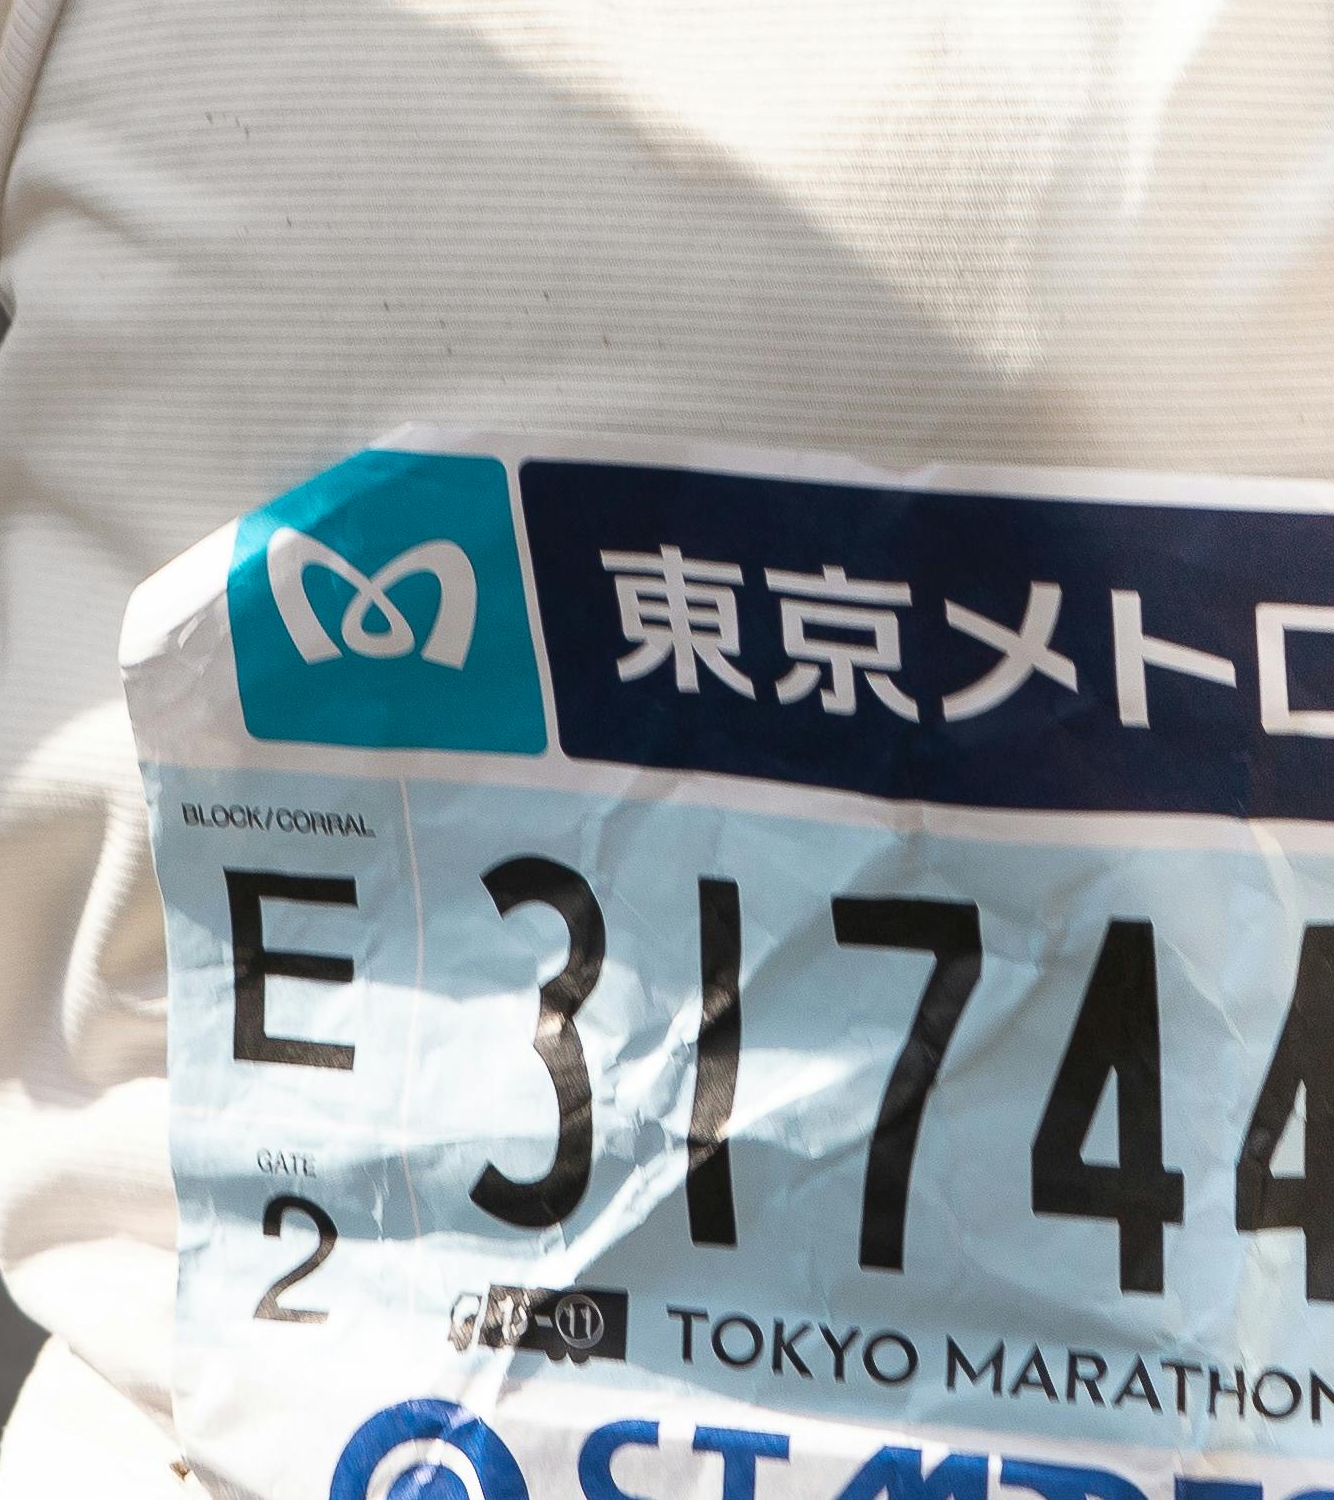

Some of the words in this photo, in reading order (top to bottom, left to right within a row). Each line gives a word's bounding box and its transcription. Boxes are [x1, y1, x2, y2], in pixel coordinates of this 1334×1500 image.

[180, 801, 376, 839] BLOCK/CORRAL
[223, 866, 359, 1071] E
[256, 1147, 318, 1179] GATE
[252, 1193, 339, 1324] 2
[667, 1303, 920, 1387] TOKYO
